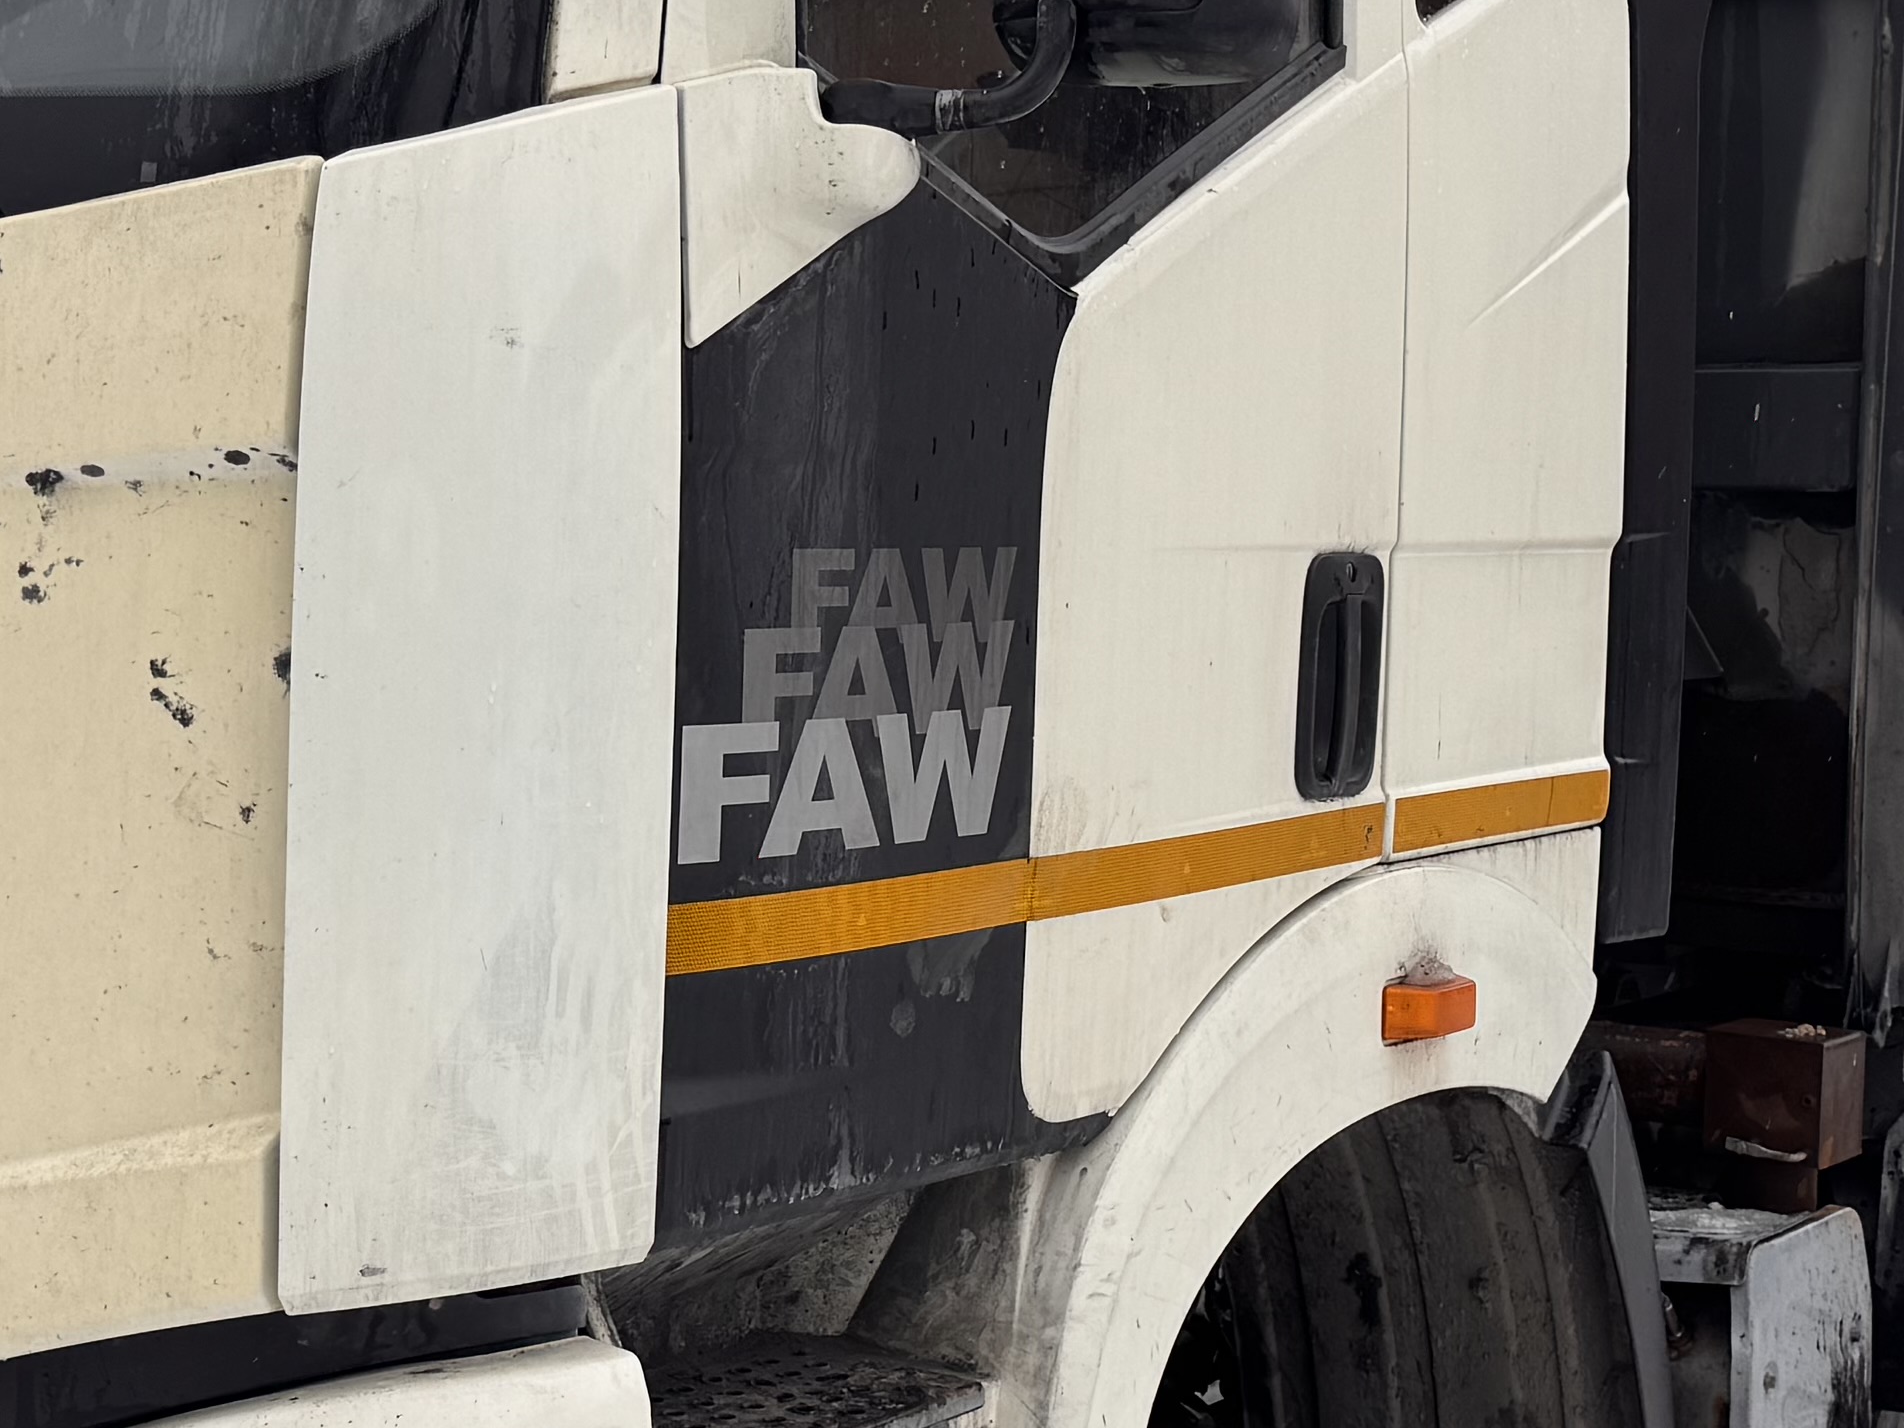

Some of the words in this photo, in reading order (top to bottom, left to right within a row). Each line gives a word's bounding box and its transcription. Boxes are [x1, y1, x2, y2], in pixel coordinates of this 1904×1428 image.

[791, 546, 1018, 644] FAW
[742, 620, 1015, 738] FAW
[677, 705, 1012, 865] FAW
